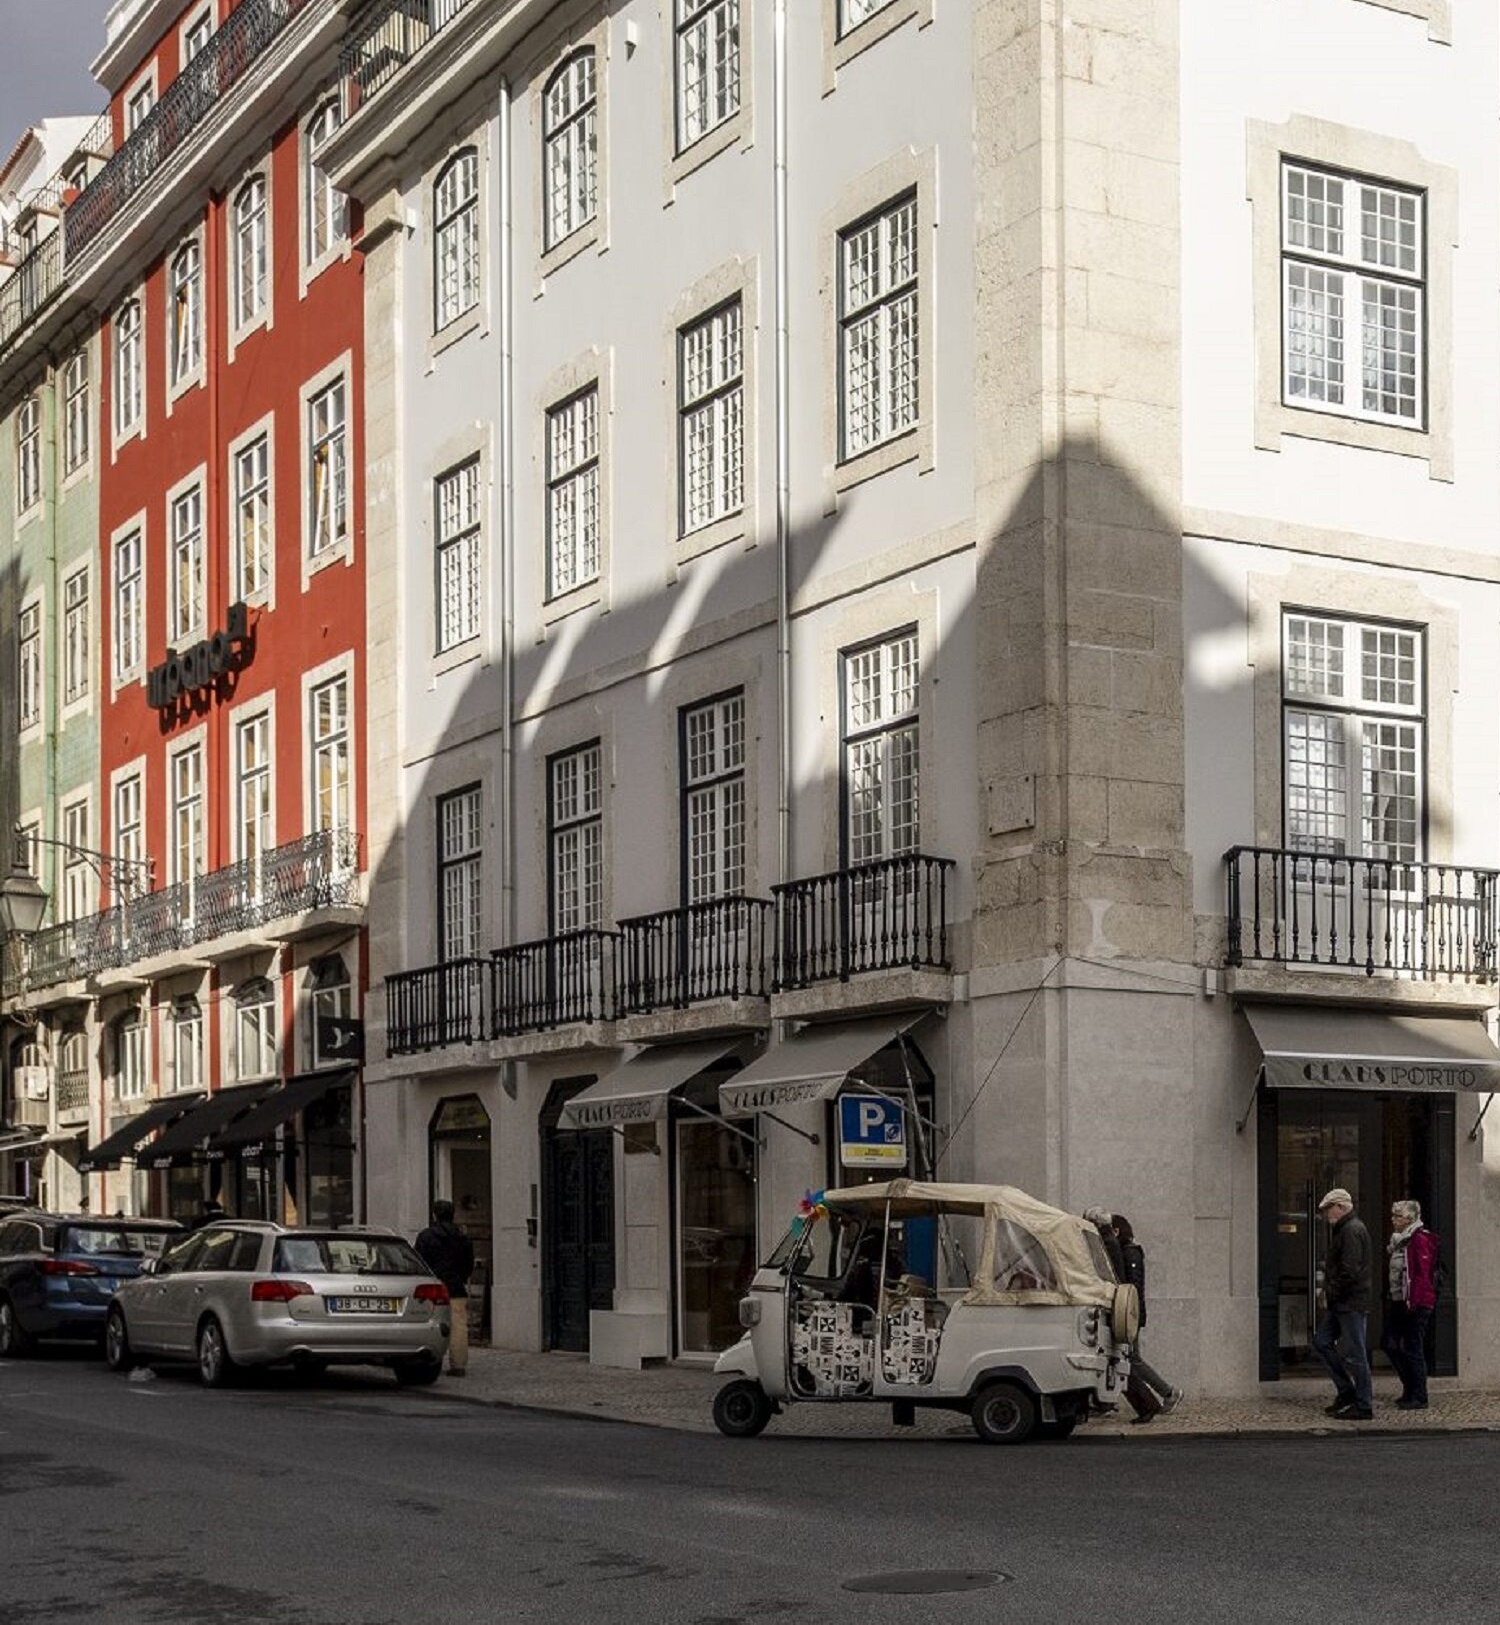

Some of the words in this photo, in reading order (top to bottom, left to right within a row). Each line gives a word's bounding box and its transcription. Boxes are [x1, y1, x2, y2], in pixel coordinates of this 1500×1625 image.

[1302, 1062, 1386, 1085] CLAUS
[1391, 1066, 1476, 1088] PORTO
[860, 1102, 885, 1137] P
